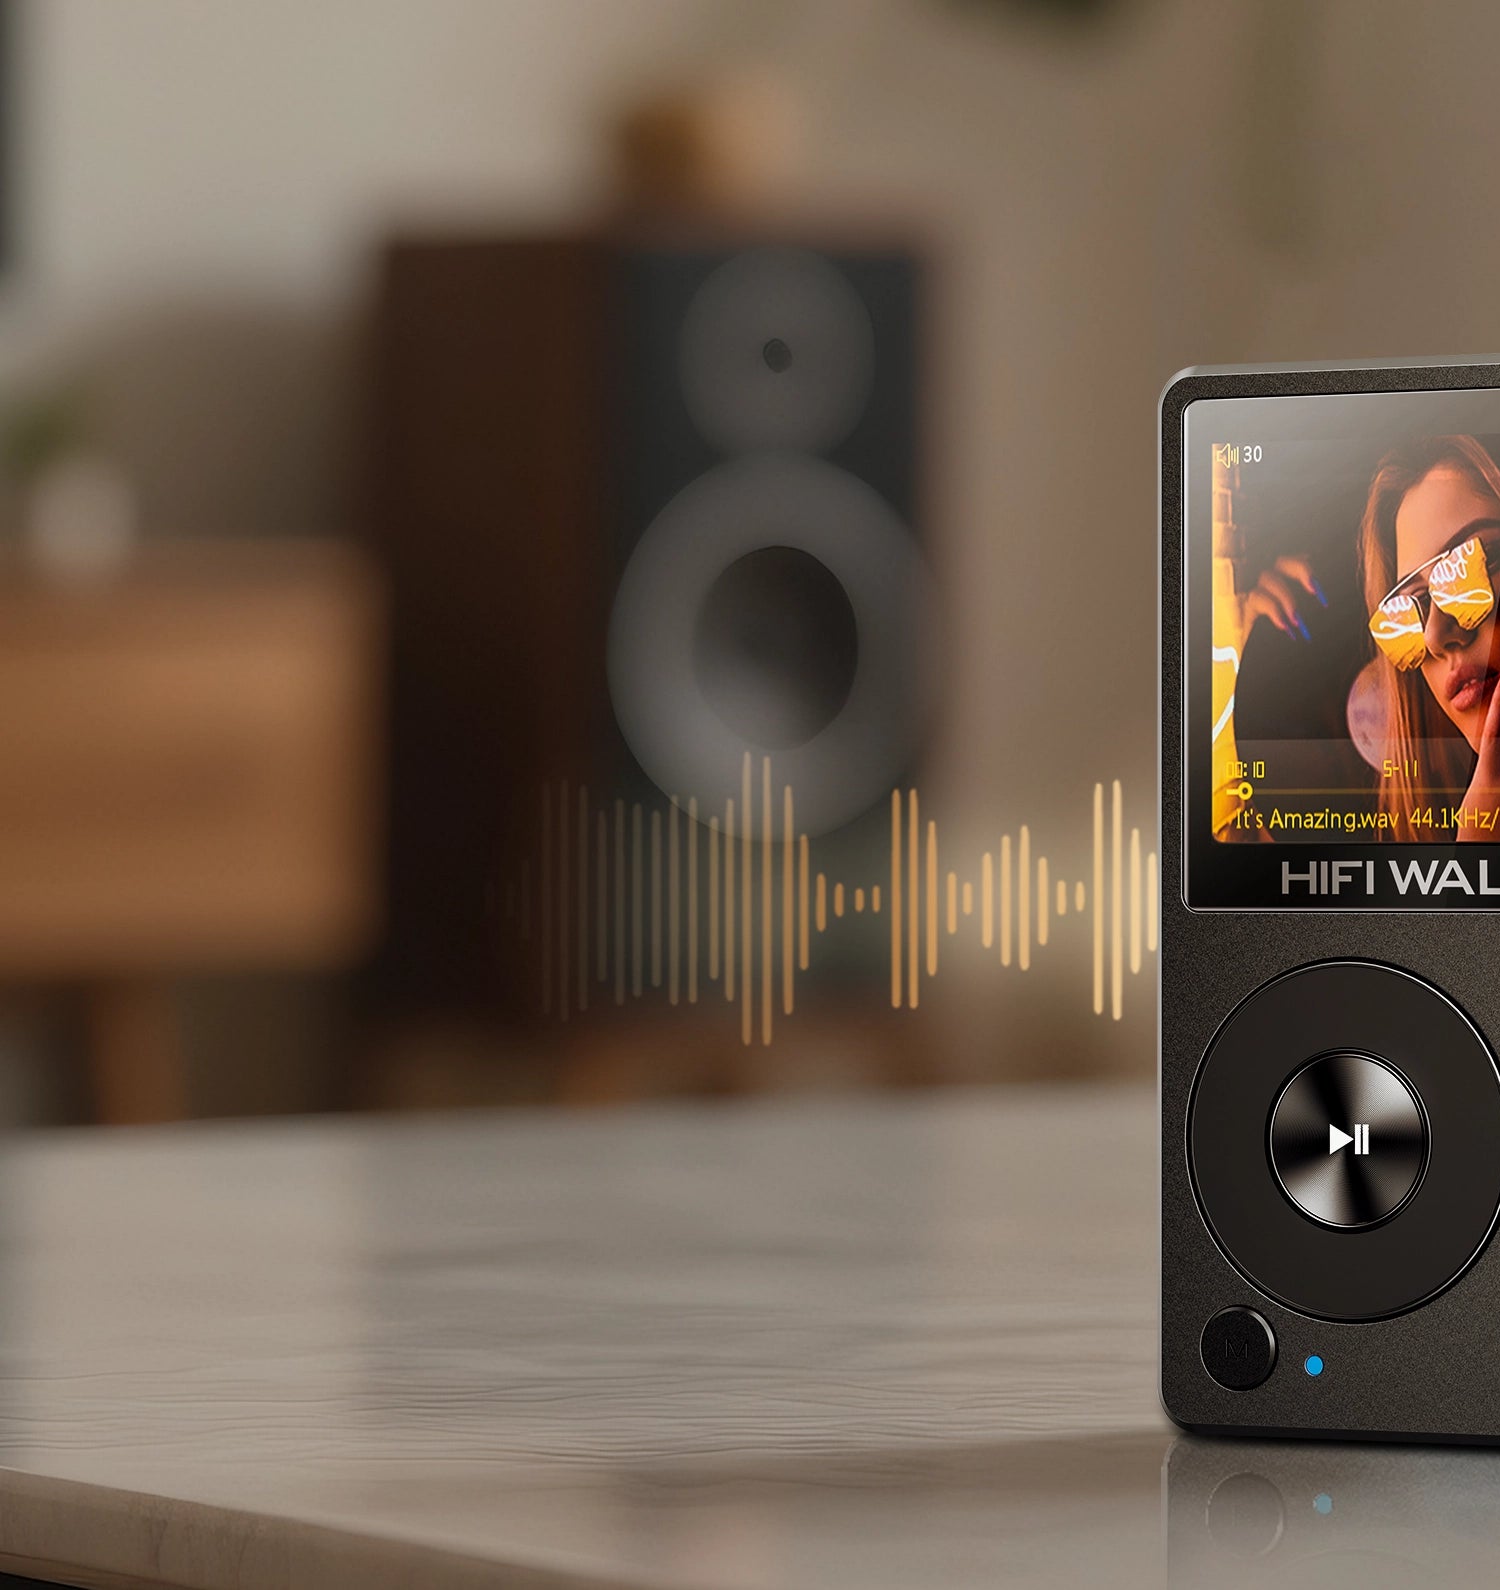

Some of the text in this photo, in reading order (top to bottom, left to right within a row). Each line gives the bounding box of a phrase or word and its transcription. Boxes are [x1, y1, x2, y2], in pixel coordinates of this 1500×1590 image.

[1243, 445, 1263, 463] 30
[1236, 808, 1263, 830] It's
[1269, 807, 1400, 832] Amazing.wav
[1281, 860, 1375, 895] HIFI
